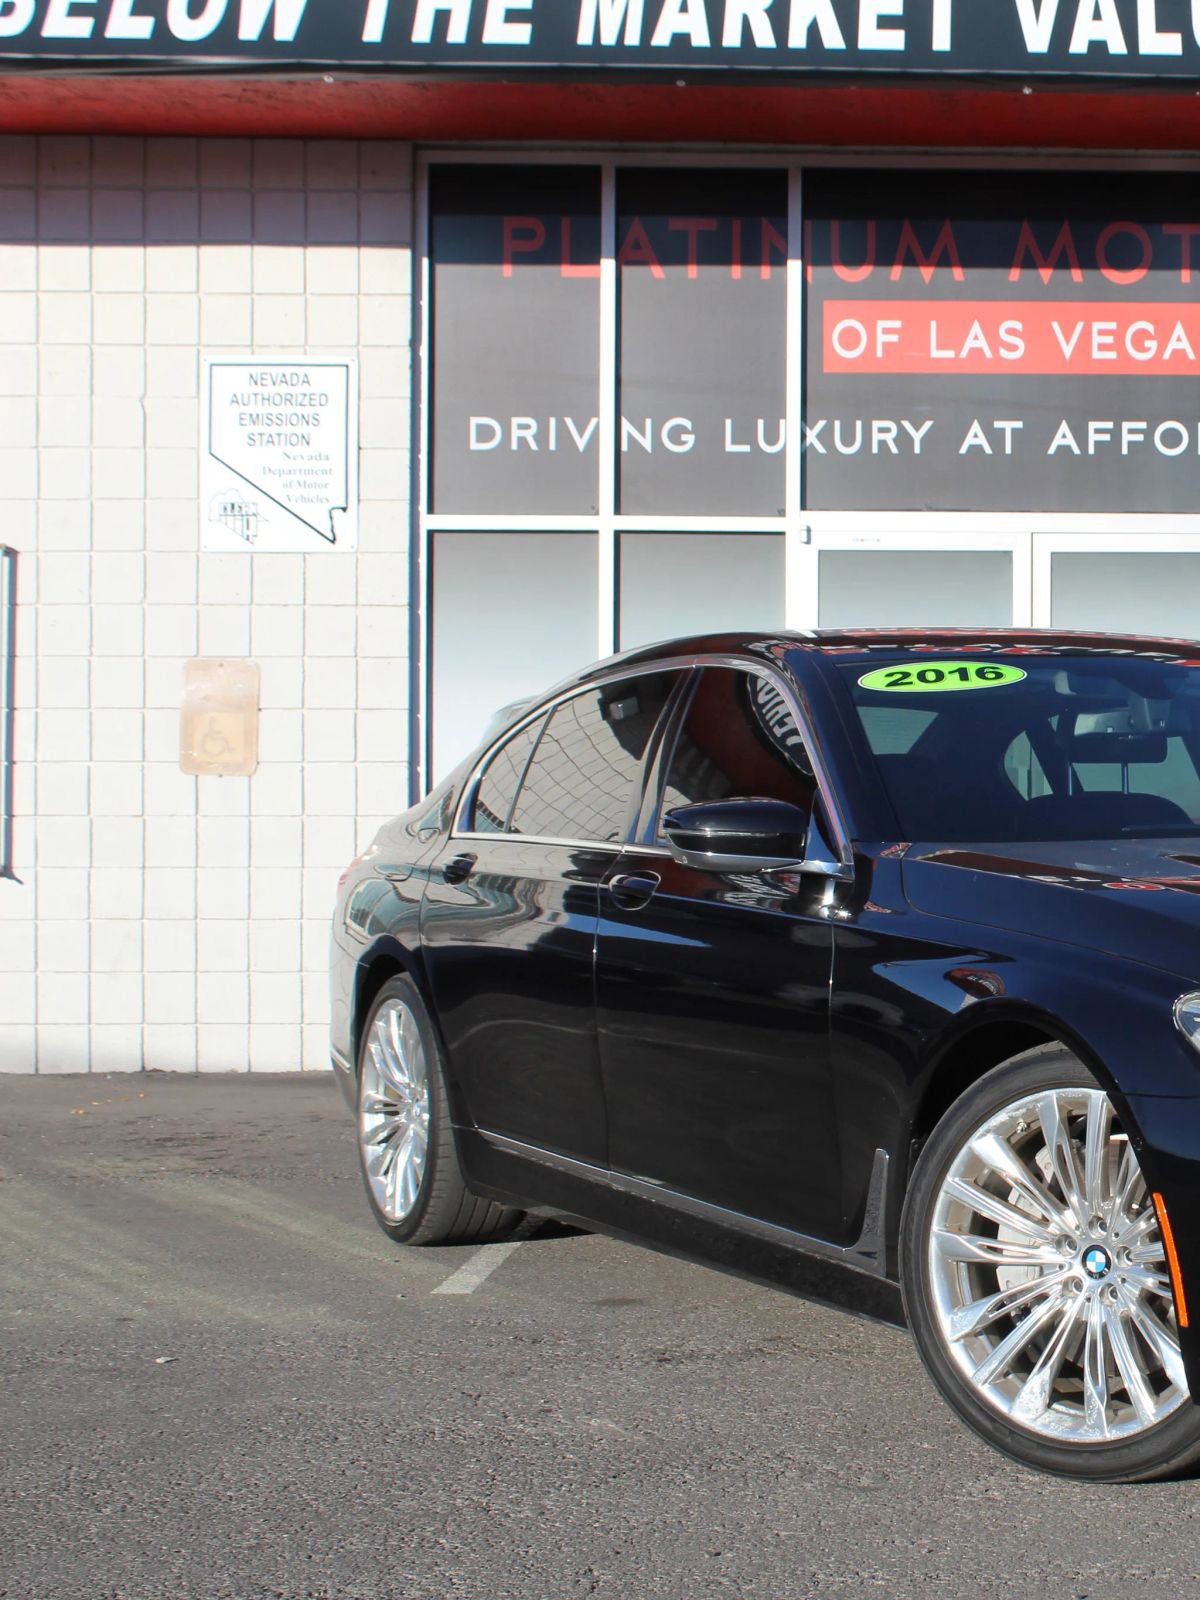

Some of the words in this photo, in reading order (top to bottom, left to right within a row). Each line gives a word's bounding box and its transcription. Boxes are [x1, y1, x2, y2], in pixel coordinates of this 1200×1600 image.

[361, 0, 537, 45] THE
[576, 0, 954, 52] MARKET
[502, 216, 965, 284] PLATINUM
[831, 319, 902, 360] OF
[929, 320, 1025, 361] LAS
[249, 372, 311, 387] NEVADA
[229, 392, 329, 407] AUTHORIZED
[238, 412, 321, 427] EMISSIONS
[247, 432, 311, 447] STATION
[469, 417, 695, 453] DRIVNG
[725, 418, 934, 455] LUXURY
[958, 419, 1023, 455] AT
[884, 666, 1005, 688] 2016
